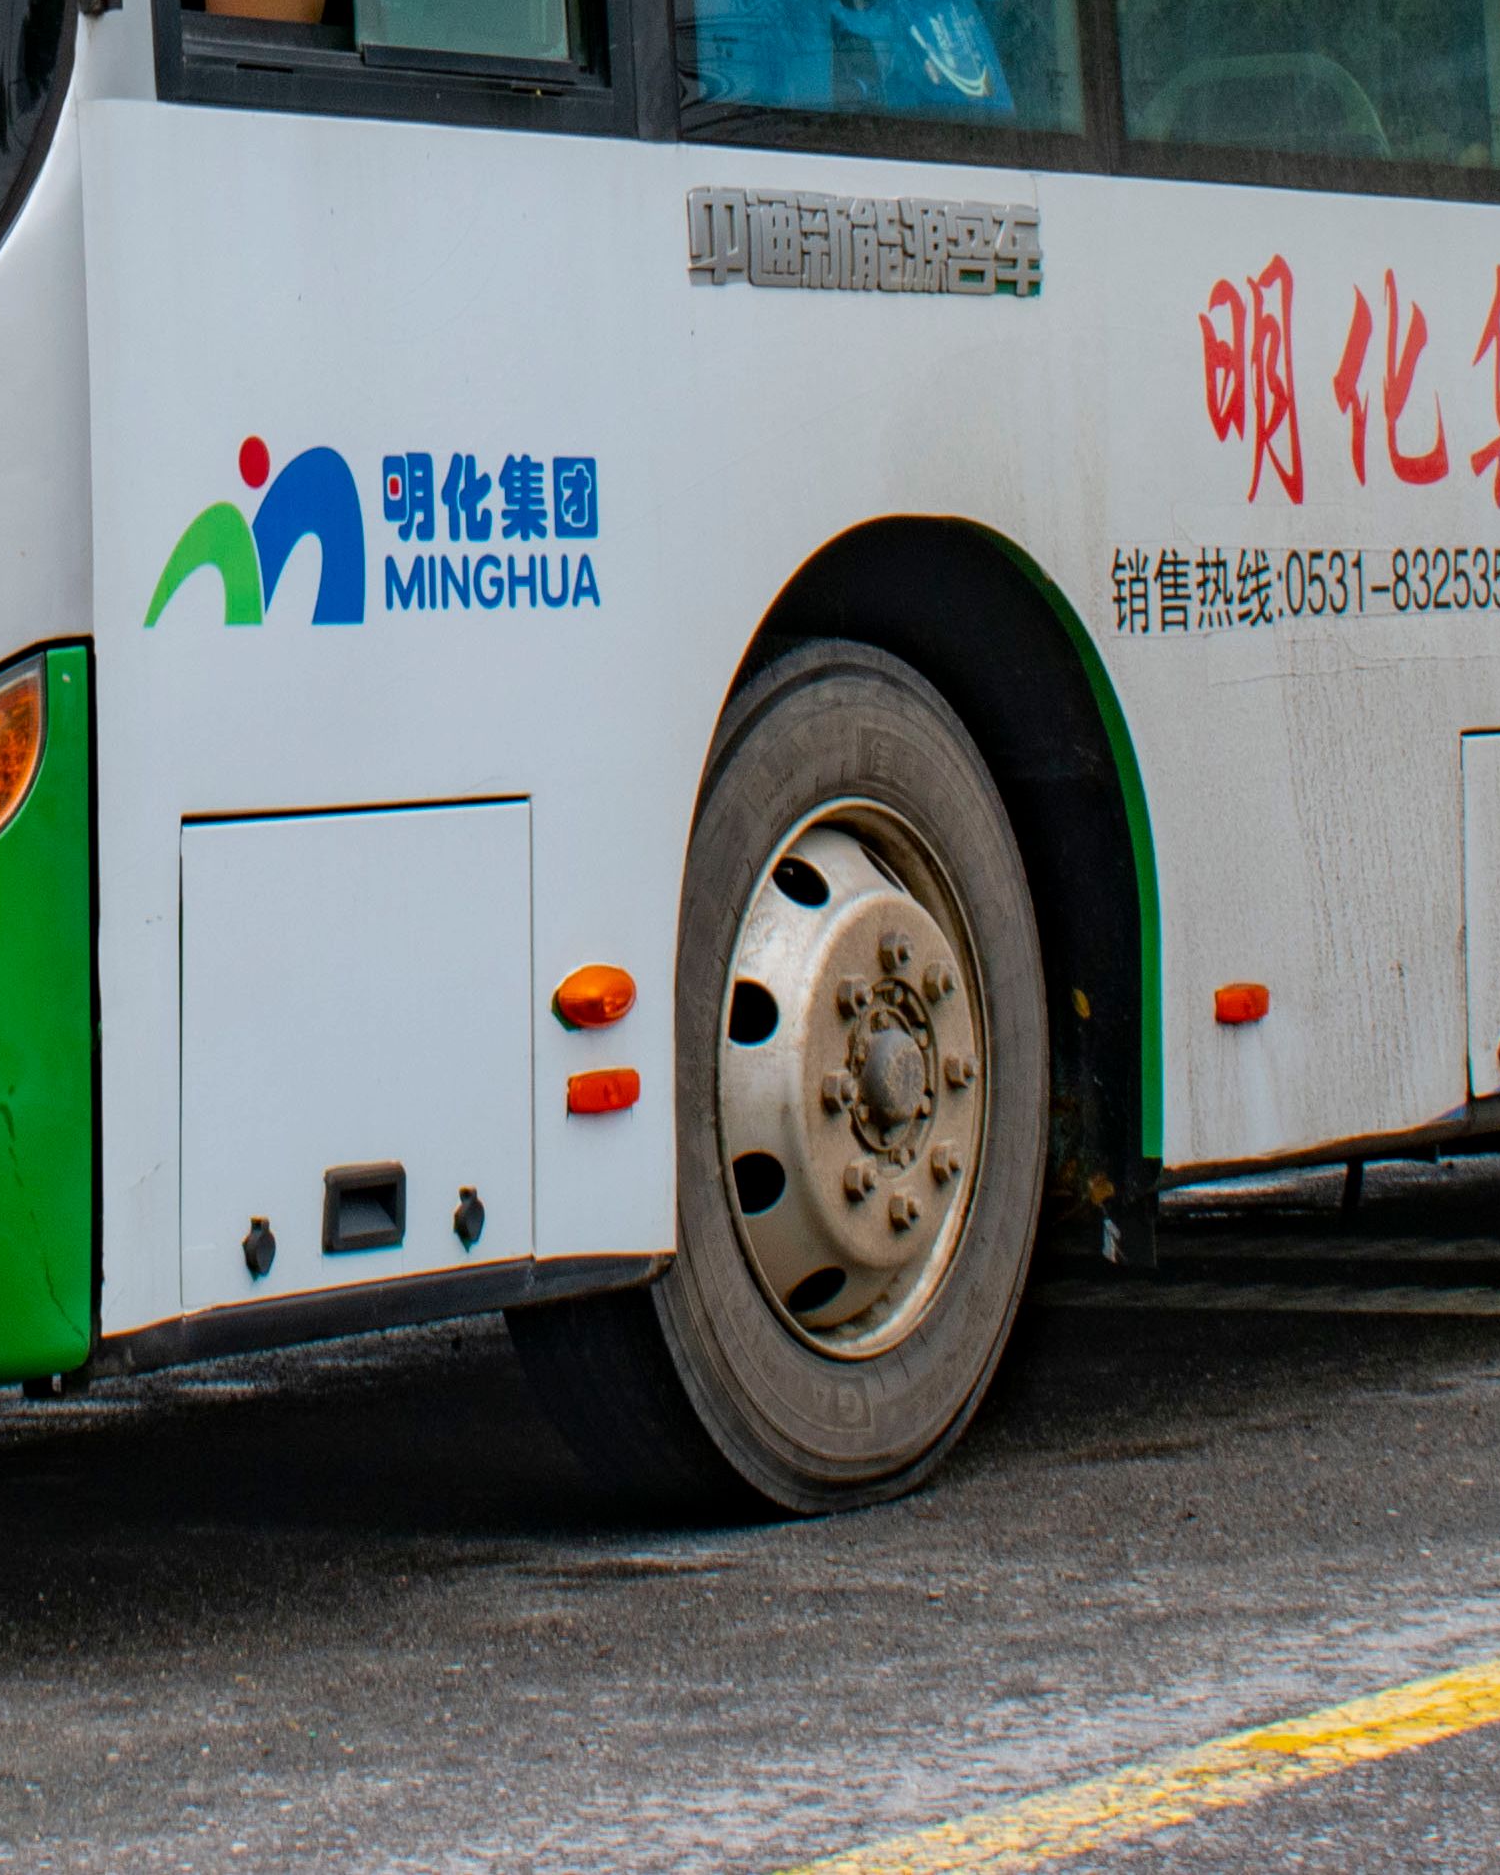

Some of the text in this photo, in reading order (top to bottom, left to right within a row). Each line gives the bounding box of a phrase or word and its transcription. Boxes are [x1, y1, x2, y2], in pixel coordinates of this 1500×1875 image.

[382, 452, 599, 542] 明化集团
[385, 554, 600, 611] MINGHUA
